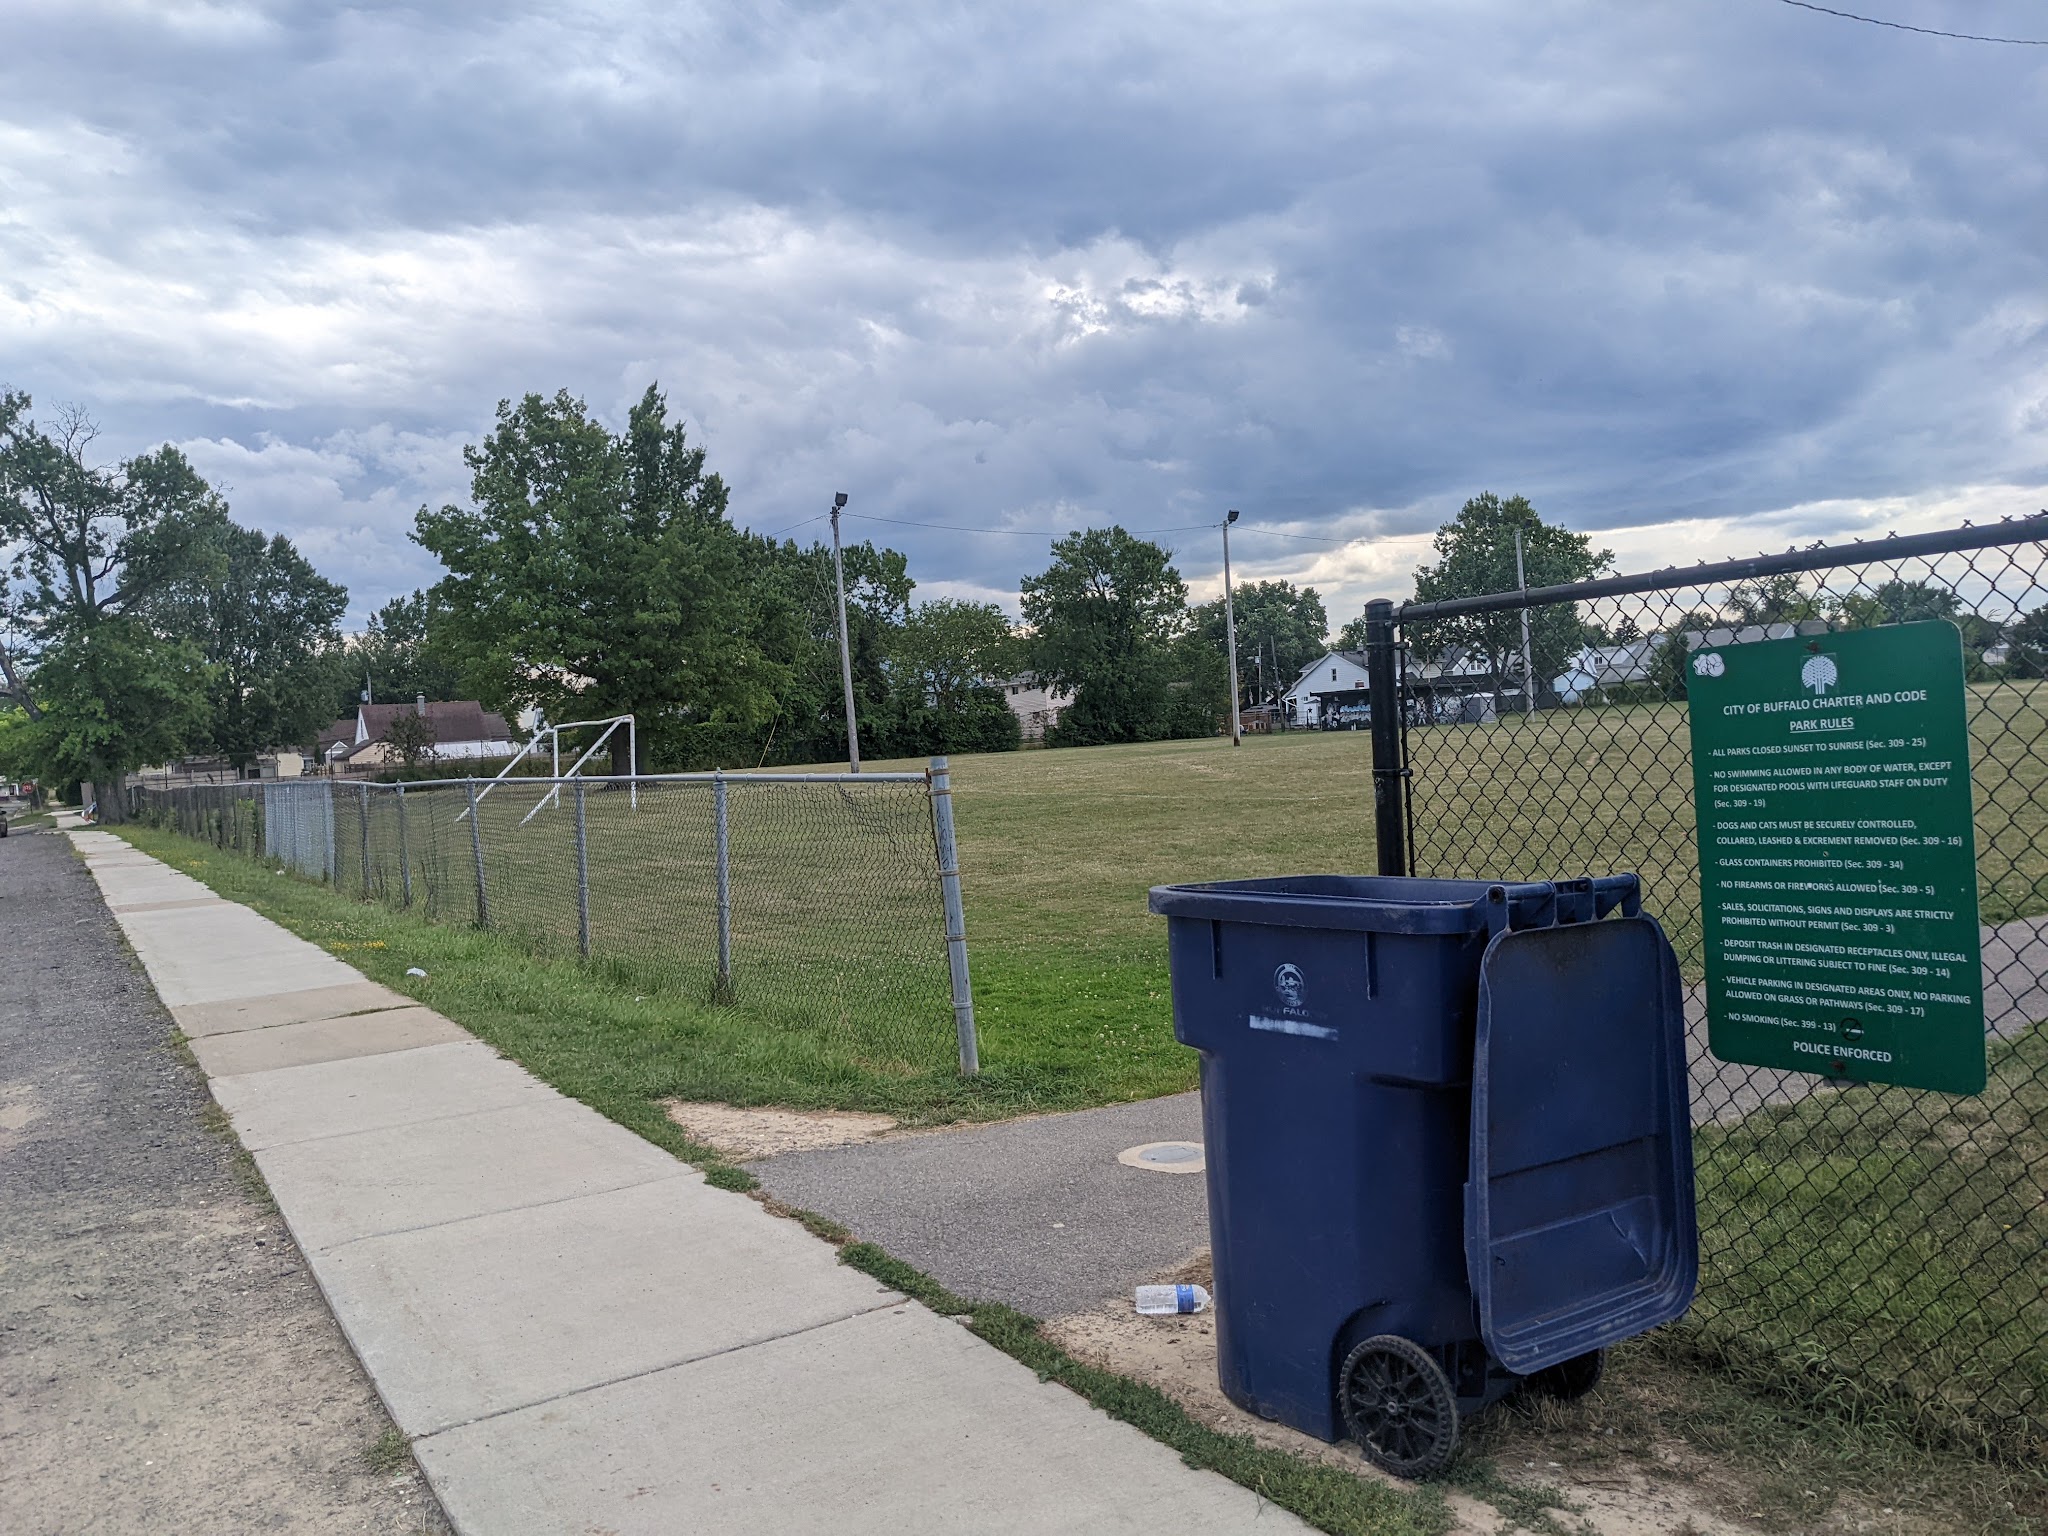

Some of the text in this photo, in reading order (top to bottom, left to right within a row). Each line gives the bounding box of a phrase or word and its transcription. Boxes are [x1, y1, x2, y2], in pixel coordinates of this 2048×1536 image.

[1723, 690, 1927, 715] CITY OF BUFFALO CHARTER AND CODE
[1789, 717, 1854, 732] PARK RULES
[1713, 748, 1726, 756] ALL
[1727, 747, 1751, 756] PARKS
[1752, 745, 1782, 754] CLOSED
[1783, 743, 1814, 753] SUNSET
[1815, 742, 1827, 751] TO
[1828, 740, 1864, 751] SUNRISE
[1866, 739, 1886, 750] (Sec.
[1888, 738, 1905, 747] 309
[1912, 737, 1927, 748] 25)
[1713, 770, 1726, 778] NO
[1726, 768, 1772, 778] SWIMMING
[1772, 767, 1812, 776] ALLOWED
[1813, 766, 1823, 774] IN
[1824, 766, 1842, 774] ANY
[1843, 764, 1868, 774] BODY
[1868, 764, 1881, 773] OF
[1882, 762, 1917, 773] WATER,
[1918, 761, 1952, 771] EXCEPT
[1713, 777, 1947, 792] FOR DESIGNATED POOLS WITH LIFEGUARD STAFF ON DUTY
[1714, 799, 1732, 809] (Sec.
[1733, 799, 1748, 807] 309
[1754, 798, 1766, 808] 19)
[1717, 821, 1739, 829] DOGS
[1740, 821, 1758, 829] AND
[1758, 821, 1778, 829] CATS
[1779, 821, 1803, 829] MUST
[1804, 820, 1815, 831] BE
[1815, 820, 1856, 828] SECURELY
[1857, 819, 1918, 829] CONTROLLED,
[1716, 836, 1757, 845] COLLARED,
[1758, 836, 1793, 844] LEASHED
[1794, 836, 1801, 844] &
[1802, 836, 1852, 845] EXCREMENT
[1854, 836, 1898, 845] REMOVED
[1899, 836, 1921, 846] (Sec.
[1923, 836, 1939, 845] 309
[1947, 836, 1963, 847] 16)
[1718, 858, 1743, 866] GLASS
[1743, 858, 1793, 867] CONTAINERS
[1793, 859, 1843, 867] PROHIBITED
[1843, 859, 1864, 869] (Sec.
[1865, 860, 1883, 868] 309
[1888, 860, 1904, 870] 34)
[1720, 880, 1733, 888] NO
[1734, 880, 1773, 889] FIREARMS
[1773, 881, 1786, 889] OR
[1787, 881, 1835, 891] FIREWORKS
[1835, 883, 1877, 892] ALLOWED
[1878, 883, 1899, 894] (Sec.
[1901, 884, 1918, 893] 309
[1924, 885, 1934, 895] 5)
[1721, 902, 1746, 912] SALES,
[1747, 903, 1806, 913] SOLICITATIONS,
[1807, 905, 1832, 914] SIGNS
[1833, 906, 1853, 915] AND
[1854, 907, 1893, 917] DISPLAYS
[1894, 909, 1912, 918] ARE
[1914, 909, 1954, 919] STRICTLY
[1721, 916, 1767, 926] PROHIBITED
[1767, 918, 1807, 928] WITHOUT
[1807, 920, 1839, 929] PERMIT
[1840, 921, 1861, 932] (Sec.
[1862, 923, 1879, 932] 309
[1885, 923, 1895, 934] 3)
[1723, 939, 1756, 948] DEPOSIT
[1756, 940, 1783, 950] TRASH
[1783, 942, 1793, 950] IN
[1794, 943, 1846, 954] DESIGNATED
[1846, 946, 1904, 958] RECEPTACLES
[1904, 949, 1930, 961] ONLY,
[1930, 951, 1968, 962] ILLEGAL
[1723, 952, 1762, 963] DUMPING
[1762, 955, 1775, 964] OR
[1775, 956, 1817, 967] LITTERING
[1817, 959, 1852, 969] SUBJECT
[1853, 962, 1866, 970] TO
[1867, 962, 1887, 972] FINE
[1888, 964, 1909, 975] (Sec.
[1911, 965, 1928, 975] 309
[1935, 967, 1950, 978] 14)
[1725, 975, 1756, 985] VEHICLE
[1758, 978, 1793, 989] PARKING
[1794, 981, 1803, 989] IN
[1804, 982, 1856, 994] DESIGNATED
[1857, 986, 1886, 996] AREAS
[1887, 988, 1911, 1001] ONLY,
[1913, 991, 1928, 1000] NO
[1929, 992, 1970, 1004] PARKING
[1725, 989, 1763, 1000] ALLOWED
[1763, 992, 1776, 1002] ON
[1777, 994, 1804, 1004] GRASS
[1805, 996, 1818, 1005] OR
[1819, 998, 1863, 1010] PATHWAYS
[1864, 1002, 1885, 1013] (Sec.
[1887, 1004, 1903, 1014] 309
[1910, 1006, 1924, 1017] 17)
[1728, 1012, 1741, 1021] NO
[1741, 1013, 1780, 1025] SMOKING
[1780, 1017, 1800, 1028] (Sec.
[1801, 1019, 1817, 1029] 399
[1823, 1022, 1837, 1032] 13)
[1793, 1041, 1892, 1062] POLICE ENFORCED
